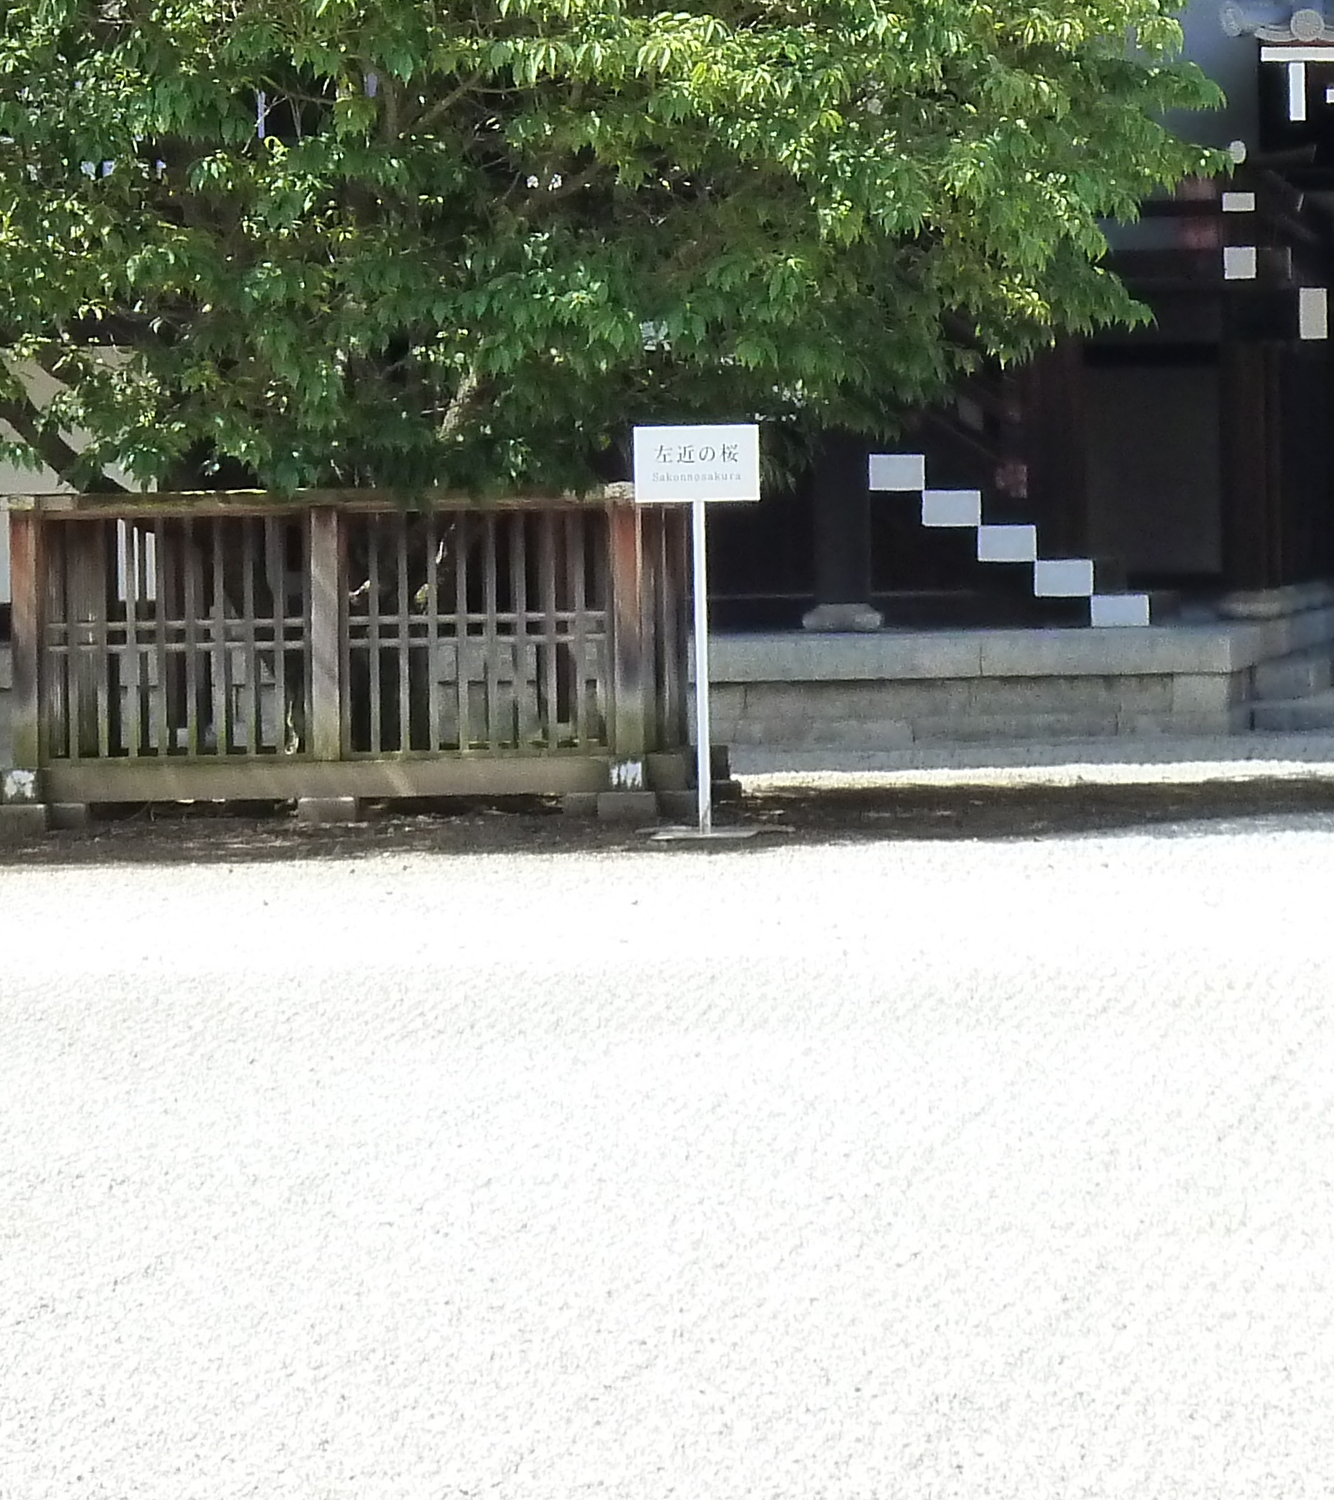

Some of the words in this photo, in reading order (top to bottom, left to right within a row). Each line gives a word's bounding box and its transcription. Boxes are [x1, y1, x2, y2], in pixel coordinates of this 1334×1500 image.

[654, 443, 739, 463] 左近の桜
[652, 471, 741, 482] Sakonnosakura
